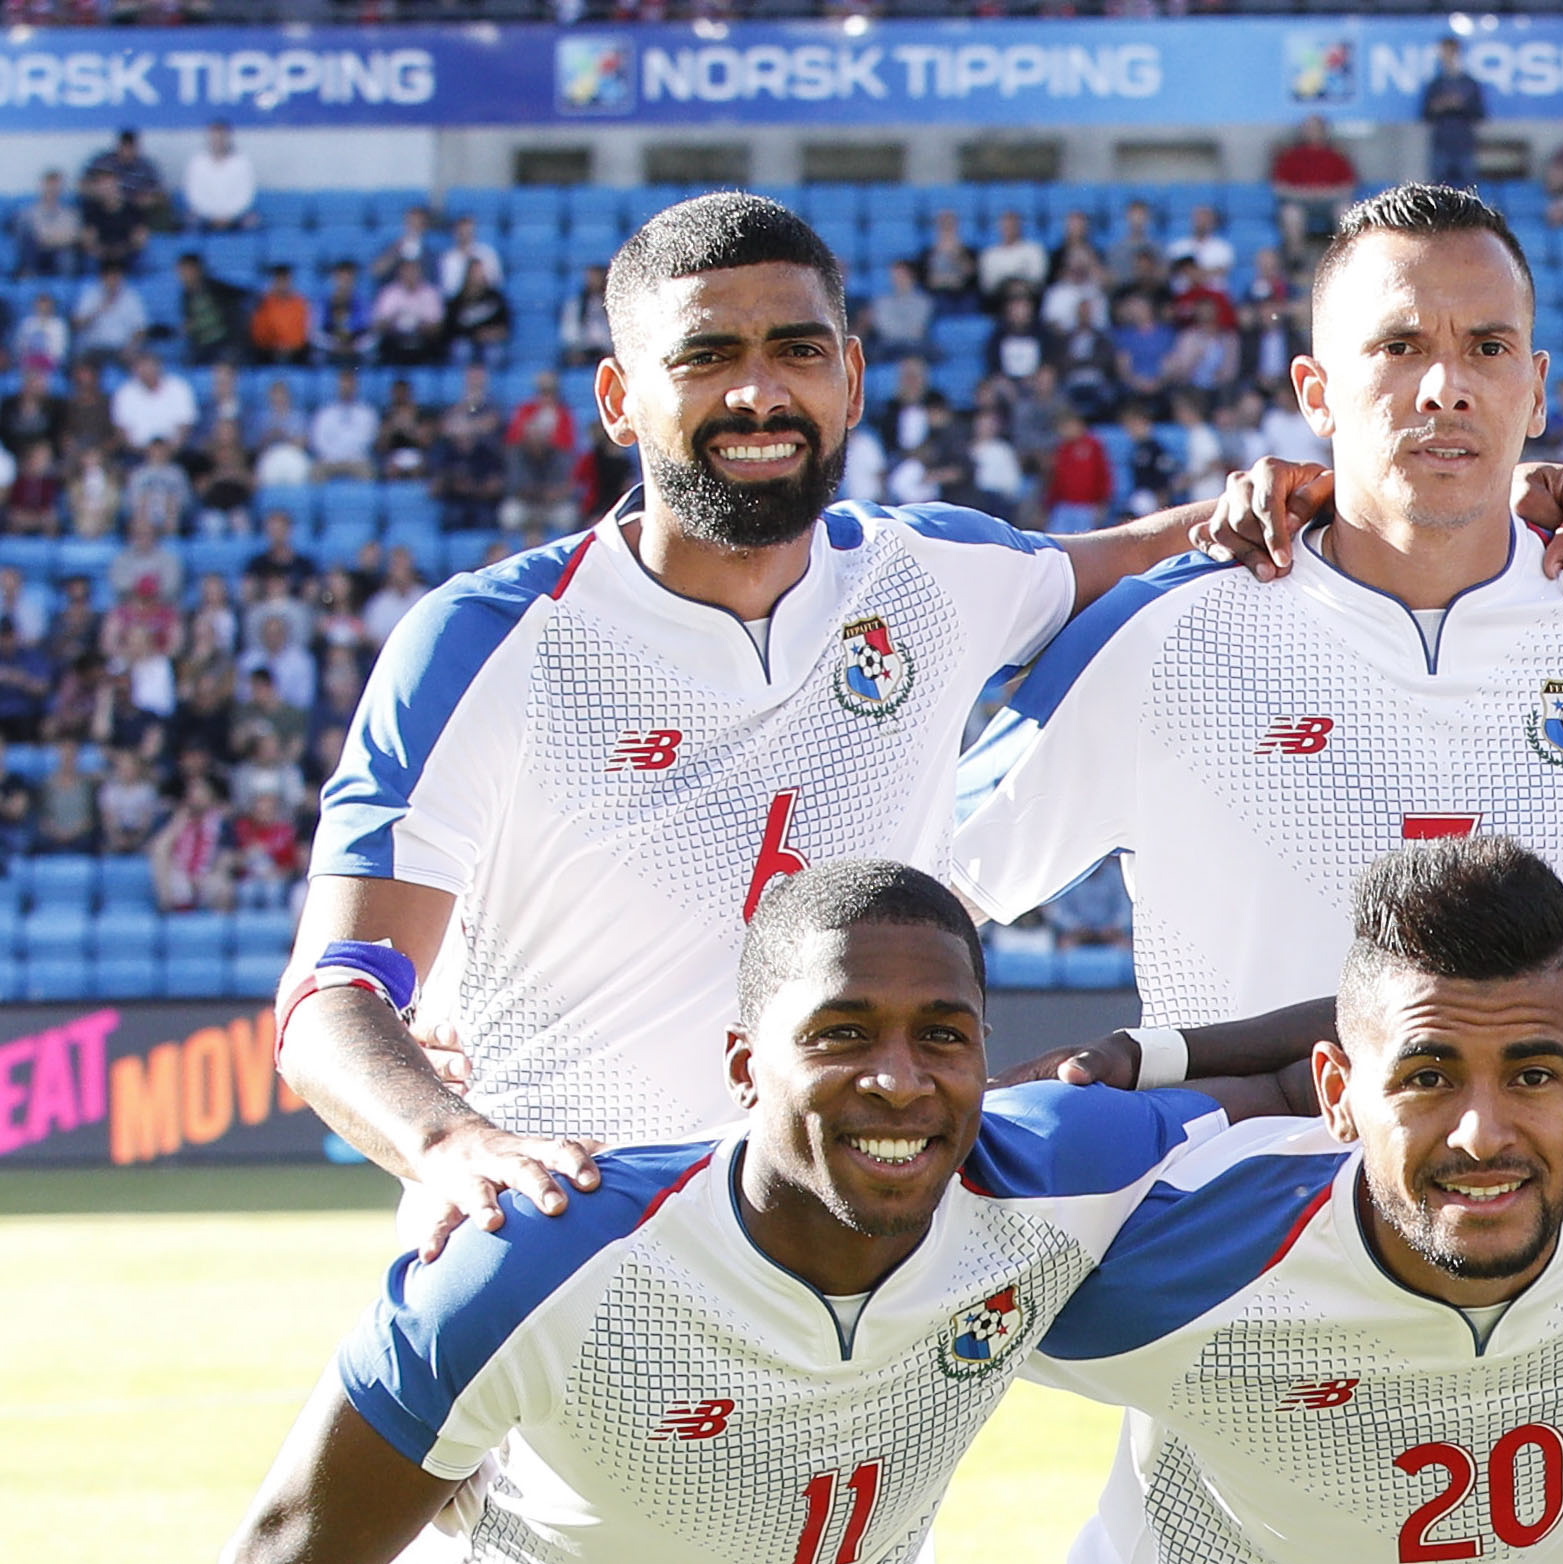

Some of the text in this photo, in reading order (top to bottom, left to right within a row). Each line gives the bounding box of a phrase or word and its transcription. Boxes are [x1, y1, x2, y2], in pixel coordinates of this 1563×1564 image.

[0, 50, 436, 106] RSK TIPPING
[644, 44, 1163, 100] NORSK TIPPING
[604, 730, 683, 772] NB
[1254, 716, 1334, 755] NB
[110, 1006, 308, 1166] MOV
[1275, 1377, 1359, 1412] NB
[647, 1398, 735, 1441] NB
